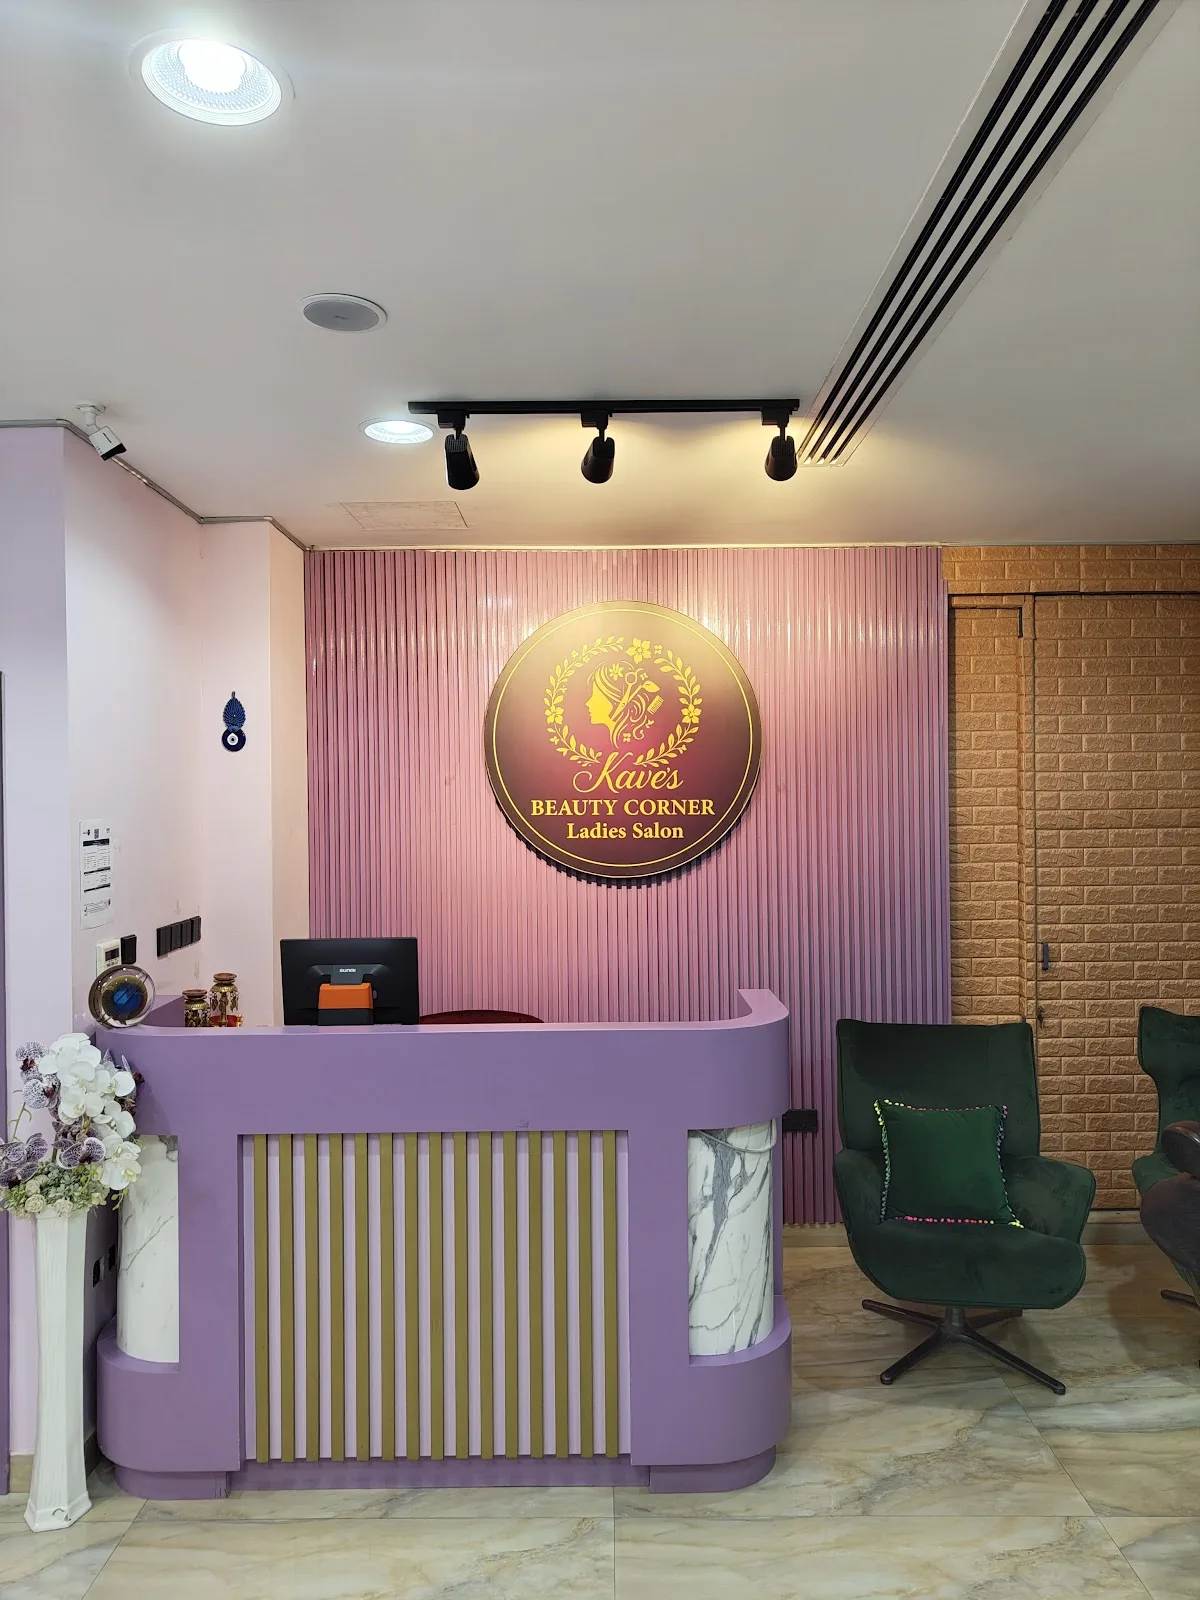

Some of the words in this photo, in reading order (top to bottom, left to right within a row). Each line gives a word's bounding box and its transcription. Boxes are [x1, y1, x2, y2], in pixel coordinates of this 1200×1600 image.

[572, 751, 684, 793] Kave's
[530, 799, 618, 816] BEAUTY
[623, 799, 715, 816] CORNER
[567, 822, 626, 839] Ladies
[632, 822, 685, 839] Salon
